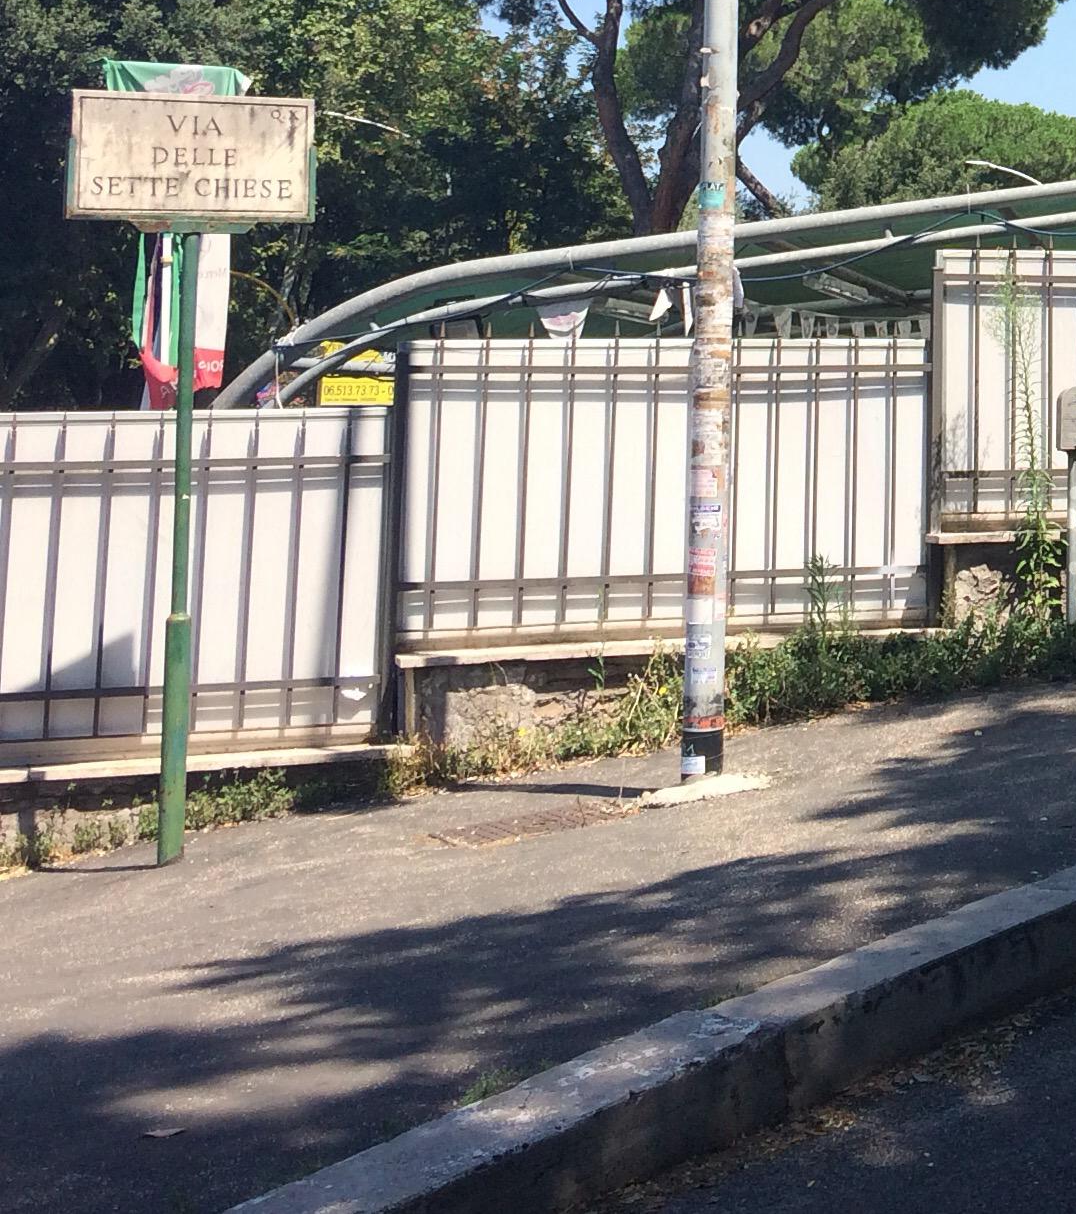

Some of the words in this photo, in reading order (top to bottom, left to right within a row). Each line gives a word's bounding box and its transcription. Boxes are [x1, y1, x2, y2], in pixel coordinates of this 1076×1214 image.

[167, 114, 223, 136] VIA
[151, 146, 237, 167] DELLE
[90, 175, 180, 198] SETTE
[194, 177, 293, 200] CHIESE
